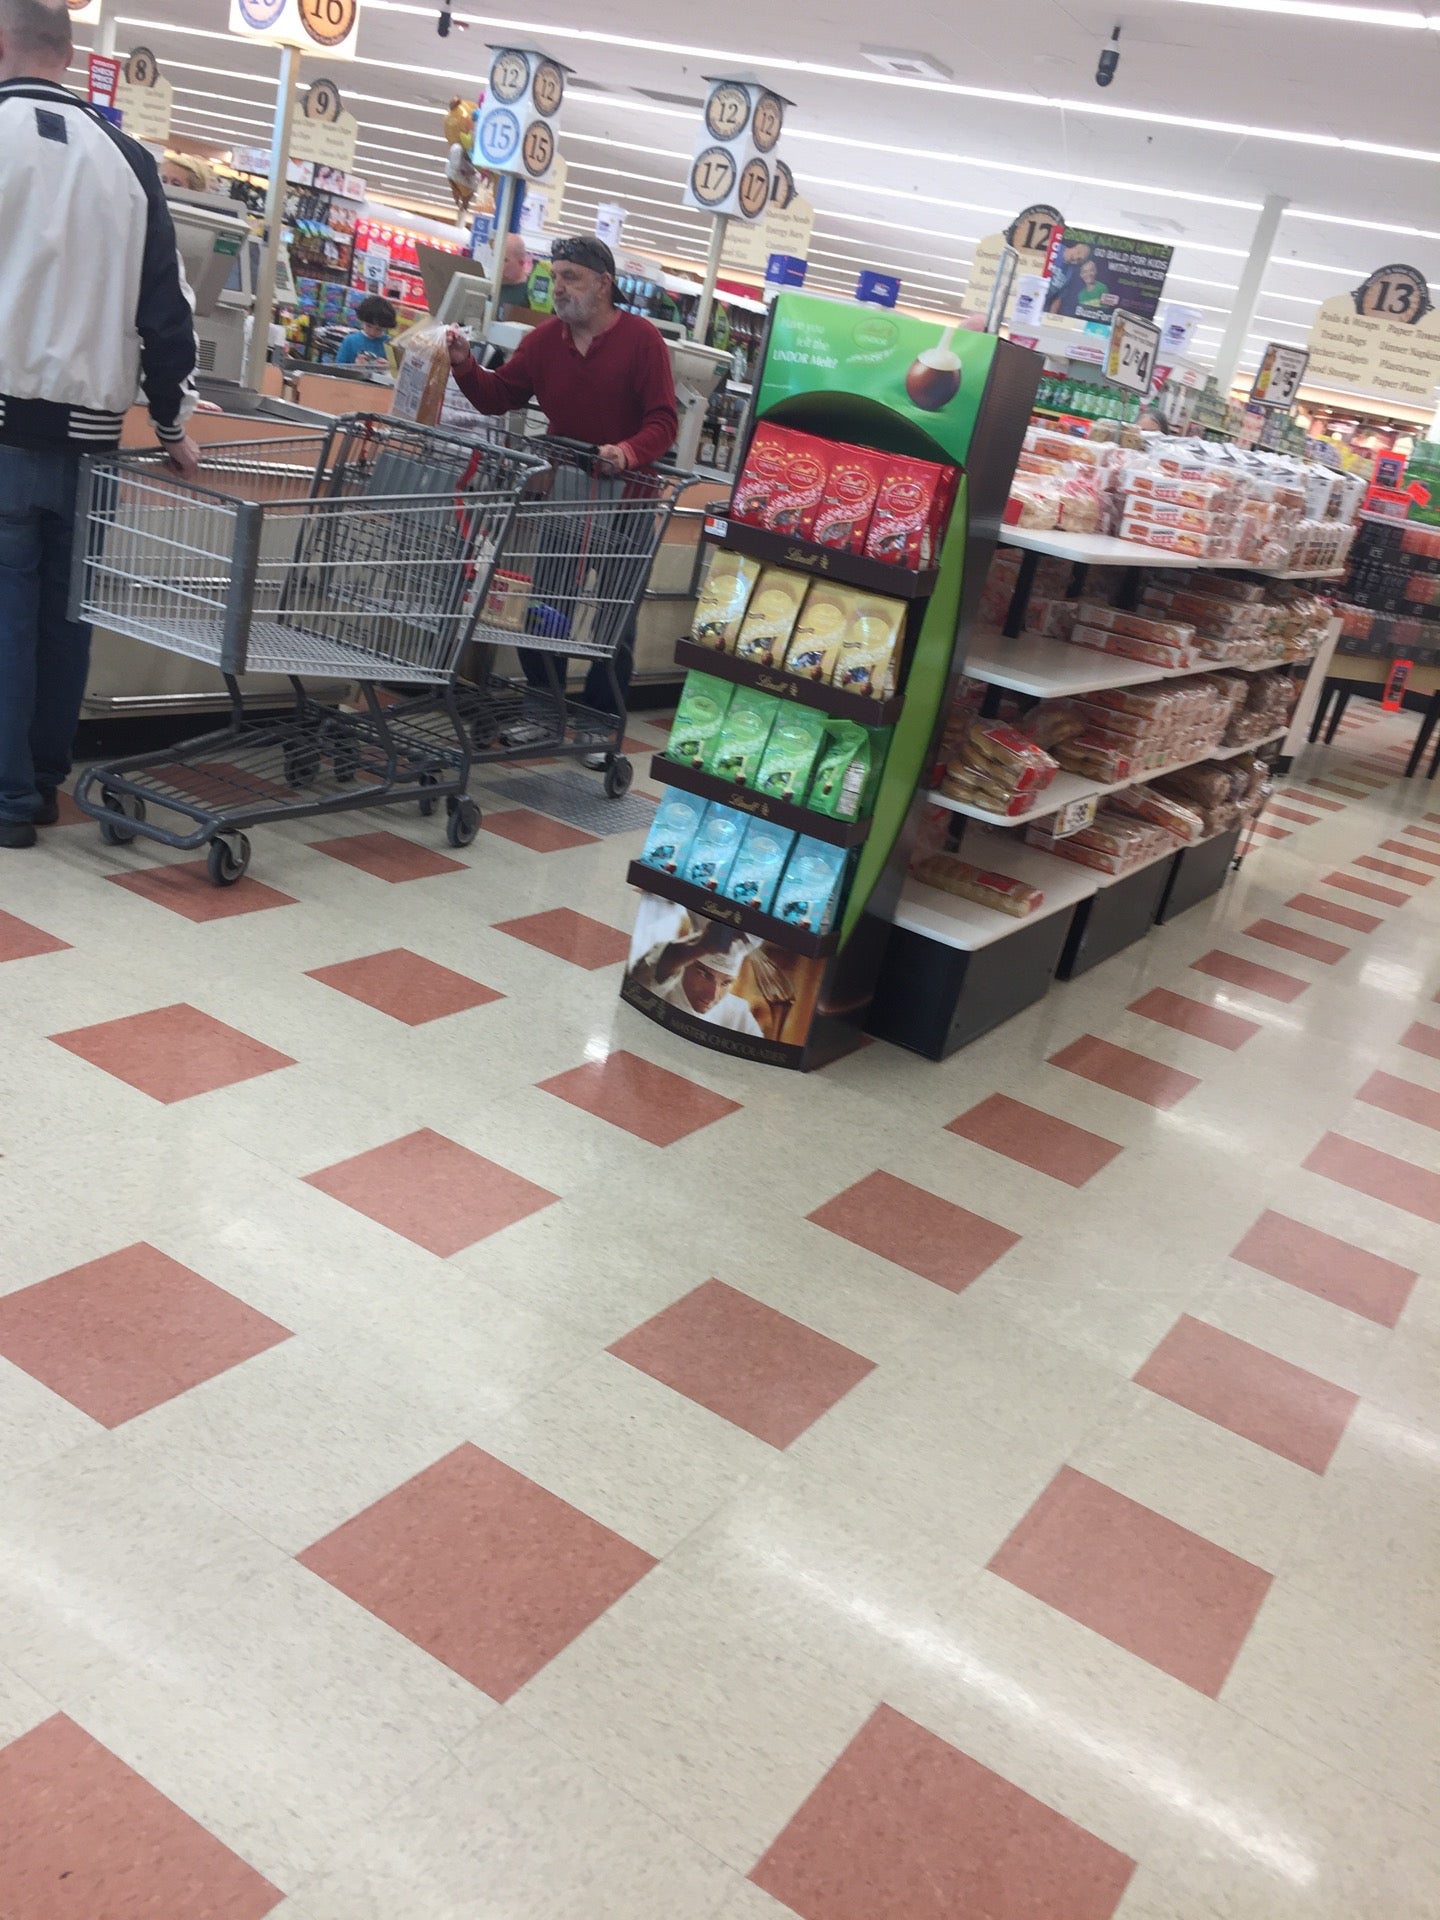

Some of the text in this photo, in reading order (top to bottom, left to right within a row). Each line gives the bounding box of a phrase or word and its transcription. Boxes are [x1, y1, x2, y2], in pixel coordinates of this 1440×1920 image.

[135, 59, 147, 81] 8
[501, 67, 520, 89] 12
[540, 78, 556, 102] 12
[315, 91, 330, 115] 9
[717, 102, 739, 124] 12
[487, 122, 511, 150] 15
[759, 112, 775, 136] 12
[529, 133, 549, 163] 15
[700, 162, 729, 191] 17
[745, 172, 766, 203] 17
[1022, 220, 1052, 252] 12
[1372, 281, 1414, 314] 13
[773, 350, 809, 365] LINDOR
